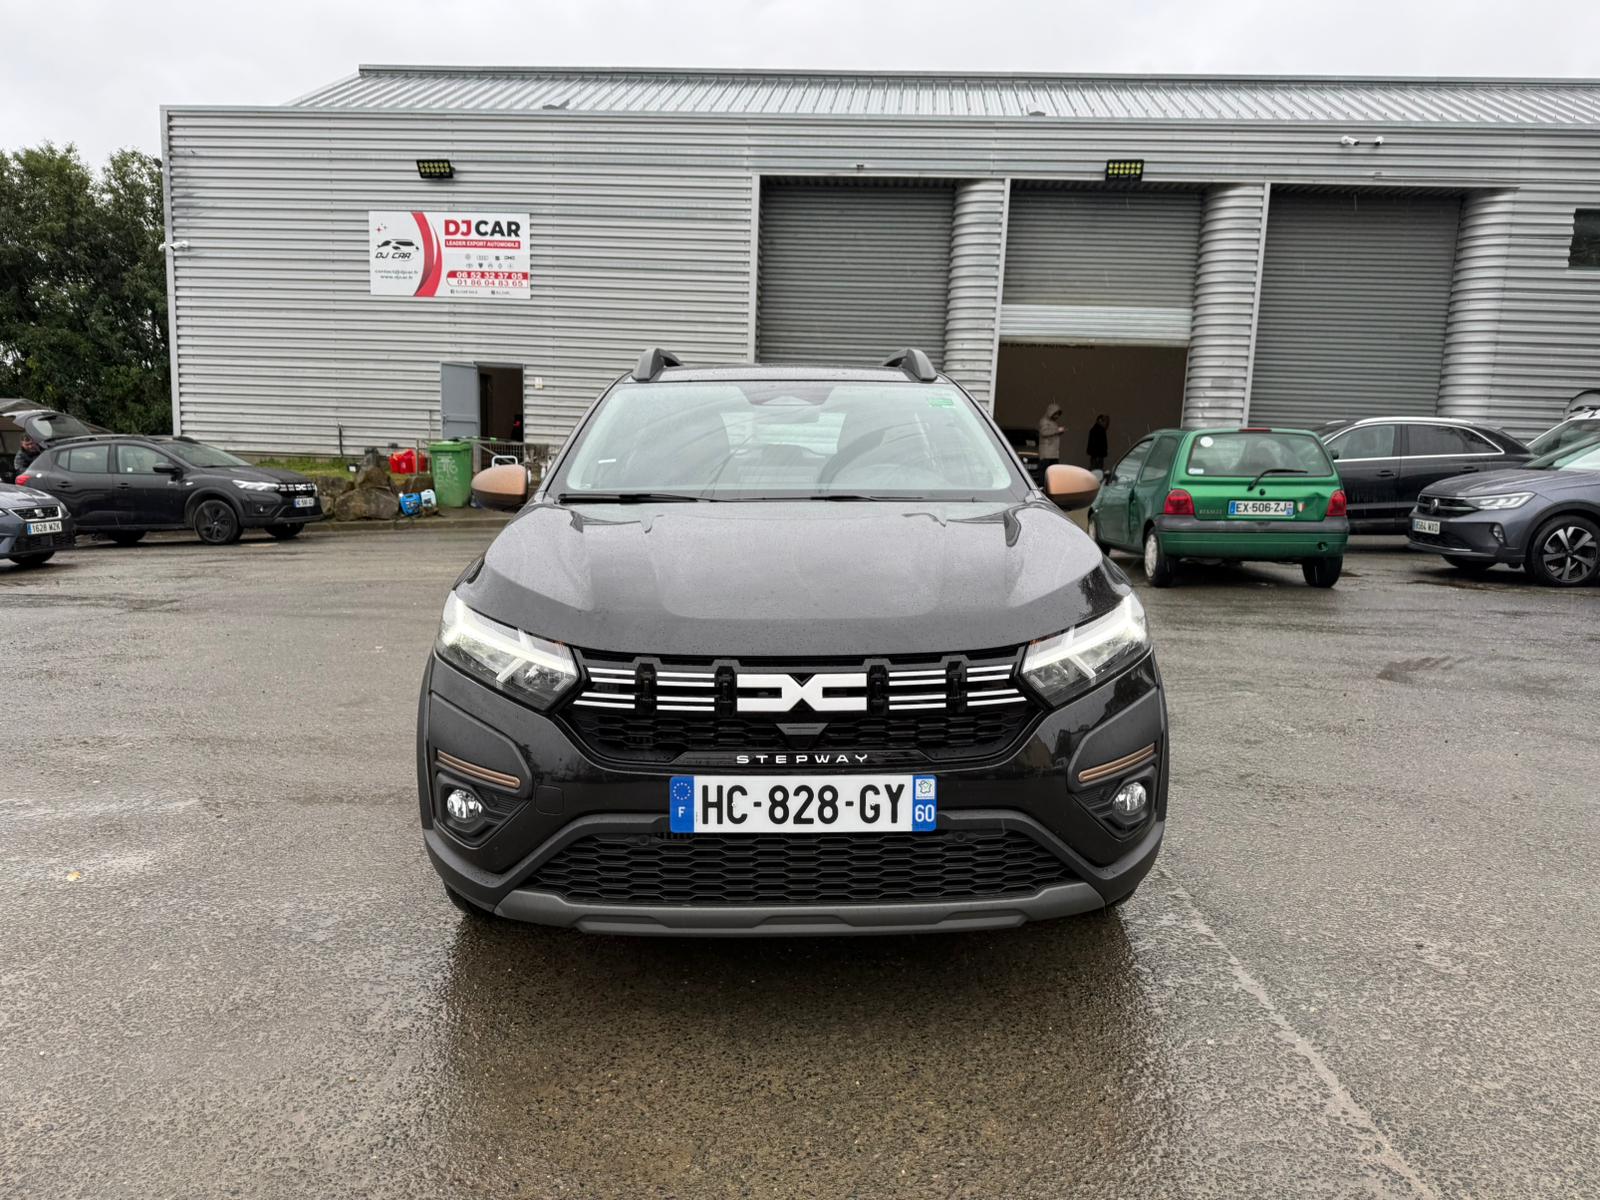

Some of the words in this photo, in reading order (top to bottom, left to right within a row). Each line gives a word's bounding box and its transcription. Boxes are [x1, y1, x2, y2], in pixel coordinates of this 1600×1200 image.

[444, 219, 472, 237] DJ
[474, 220, 521, 238] CAR
[1236, 502, 1286, 513] EX-506-ZJ
[33, 524, 48, 532] 1628
[736, 754, 868, 764] STEPWAY
[678, 806, 685, 818] F
[702, 784, 905, 825] HC-828-GY
[915, 804, 935, 822] 60
